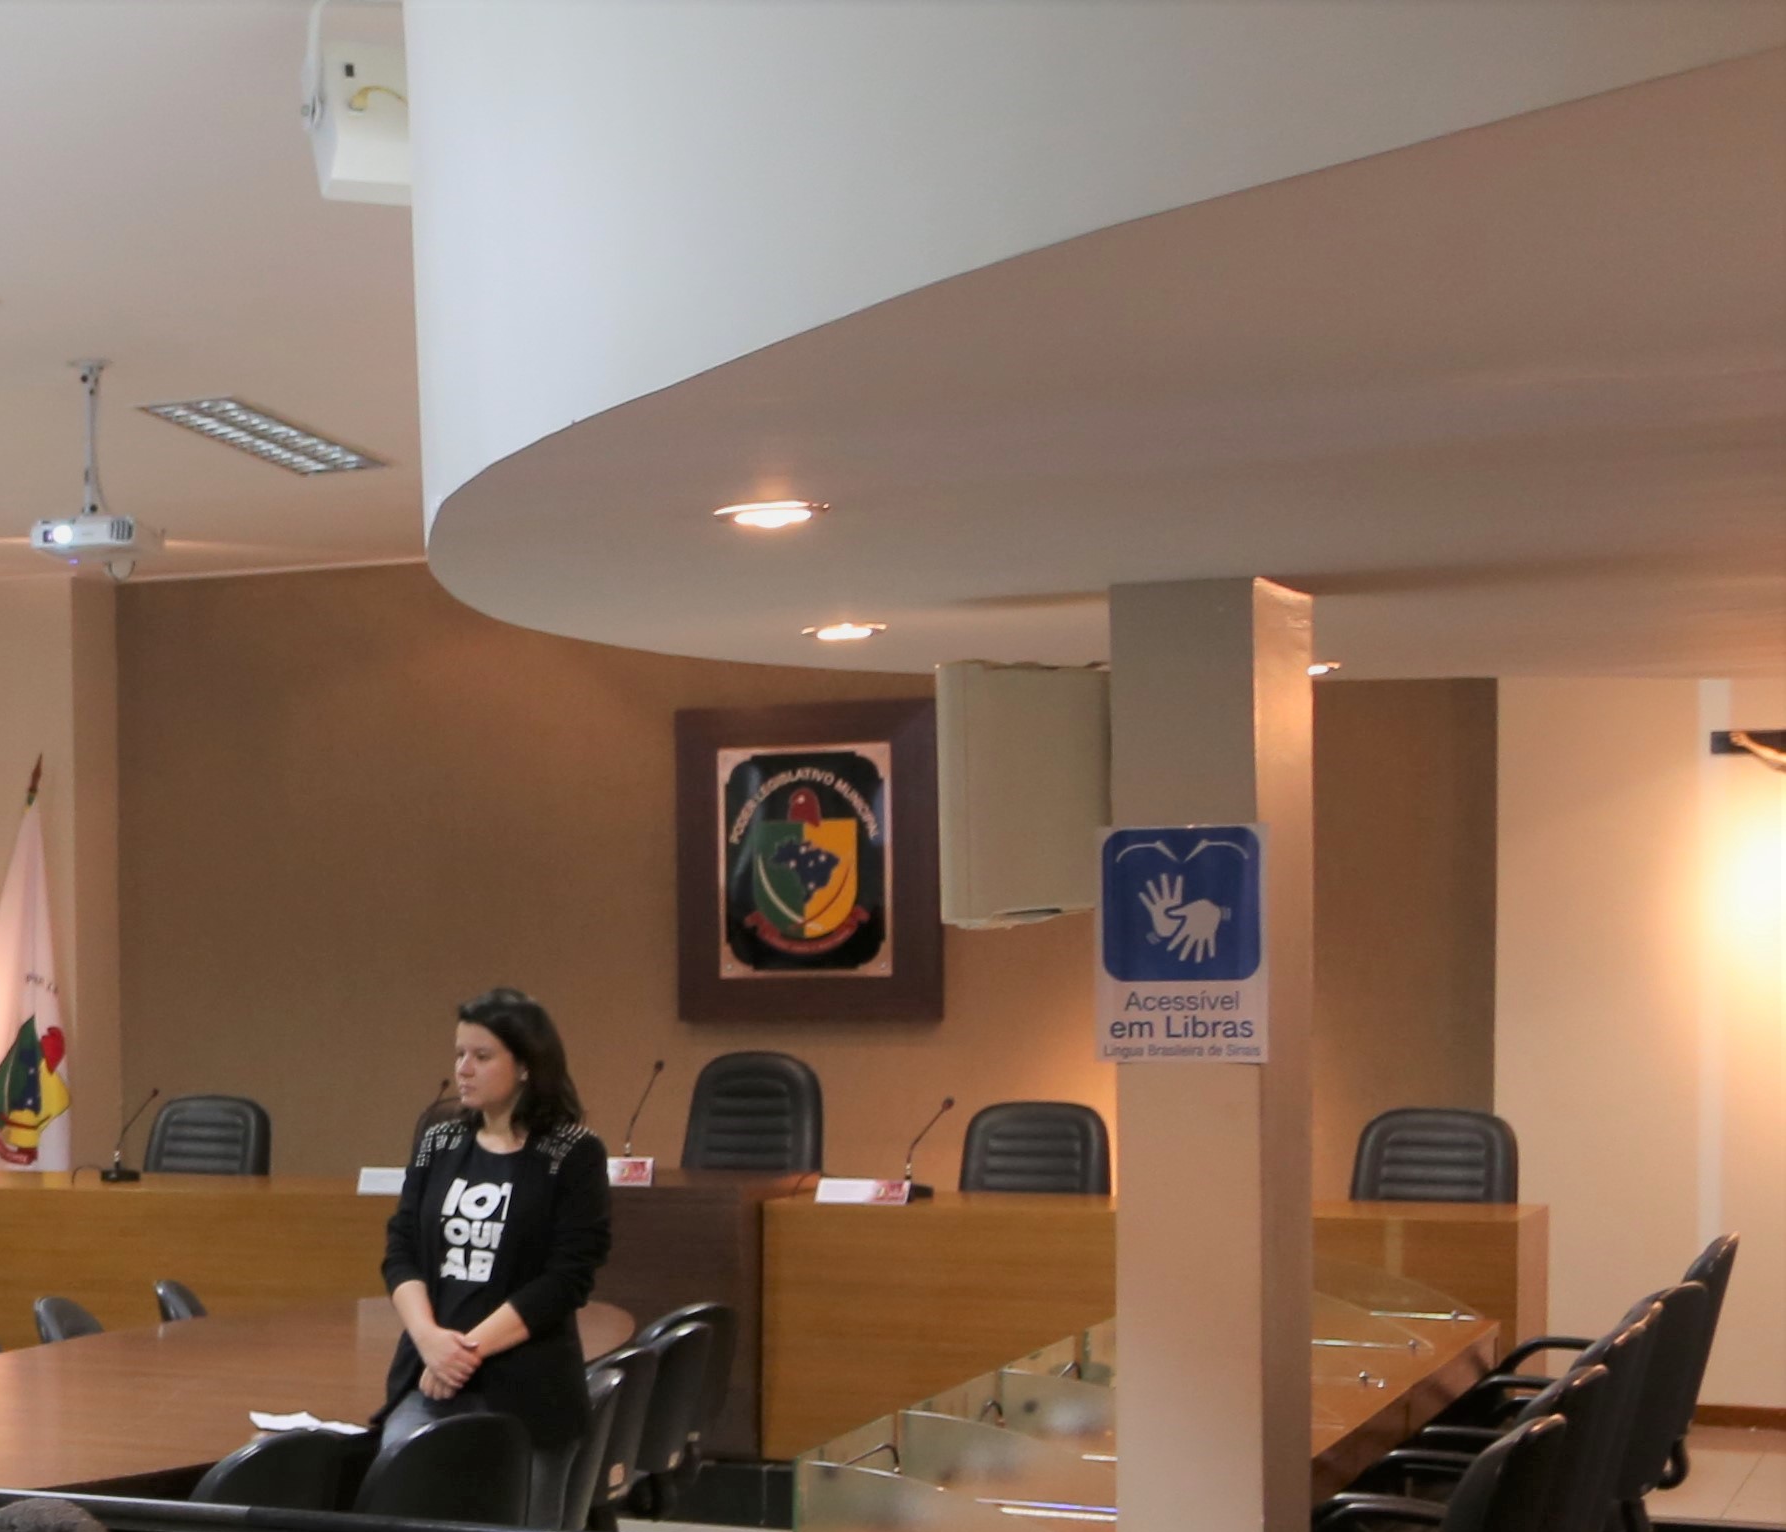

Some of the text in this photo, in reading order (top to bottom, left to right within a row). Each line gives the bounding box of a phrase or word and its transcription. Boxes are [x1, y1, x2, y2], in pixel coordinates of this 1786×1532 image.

[1124, 989, 1241, 1012] Acessível
[1109, 1015, 1255, 1039] em Libras
